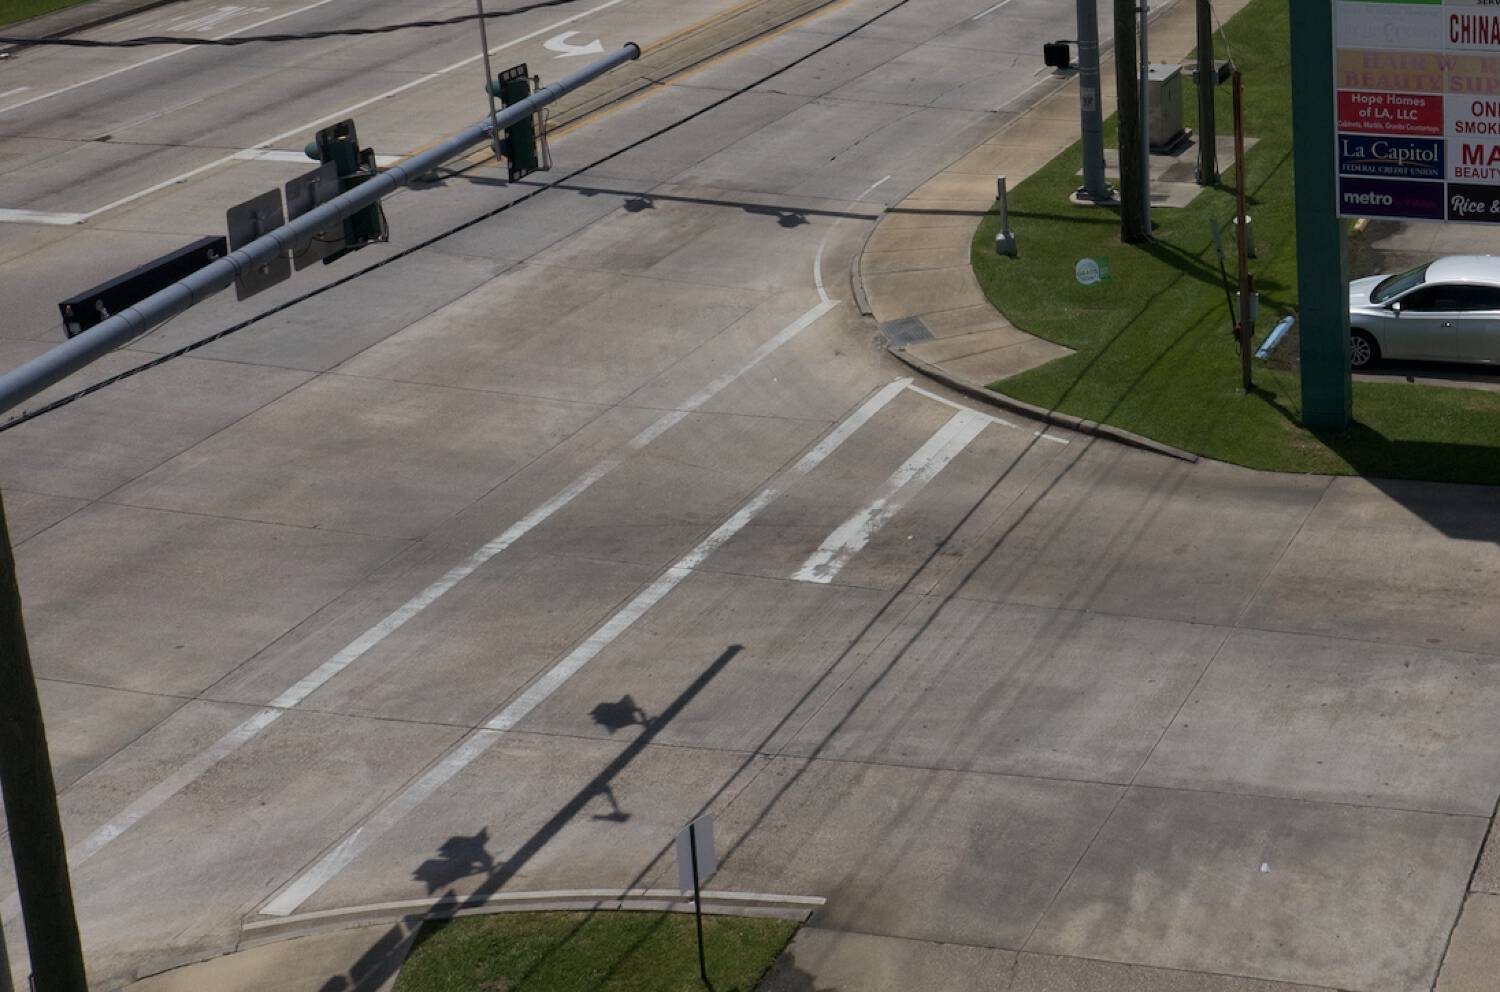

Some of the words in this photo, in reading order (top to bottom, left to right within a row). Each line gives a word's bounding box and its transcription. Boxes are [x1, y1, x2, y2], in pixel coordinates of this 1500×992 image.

[1450, 14, 1500, 45] CHINA
[1345, 71, 1442, 90] BEAUTY
[1351, 93, 1383, 105] Hope
[1386, 94, 1425, 106] Homes
[1358, 107, 1372, 117] of
[1374, 108, 1393, 119] LA,
[1396, 109, 1418, 120] LLC
[1343, 139, 1365, 158] La
[1371, 140, 1439, 166] Capitol
[1342, 163, 1376, 173] FEDERAL
[1378, 166, 1408, 175] CREDIT
[1410, 167, 1439, 176] UNION
[1343, 191, 1393, 206] metro
[1451, 194, 1486, 217] Rice
[1489, 199, 1500, 214] &
